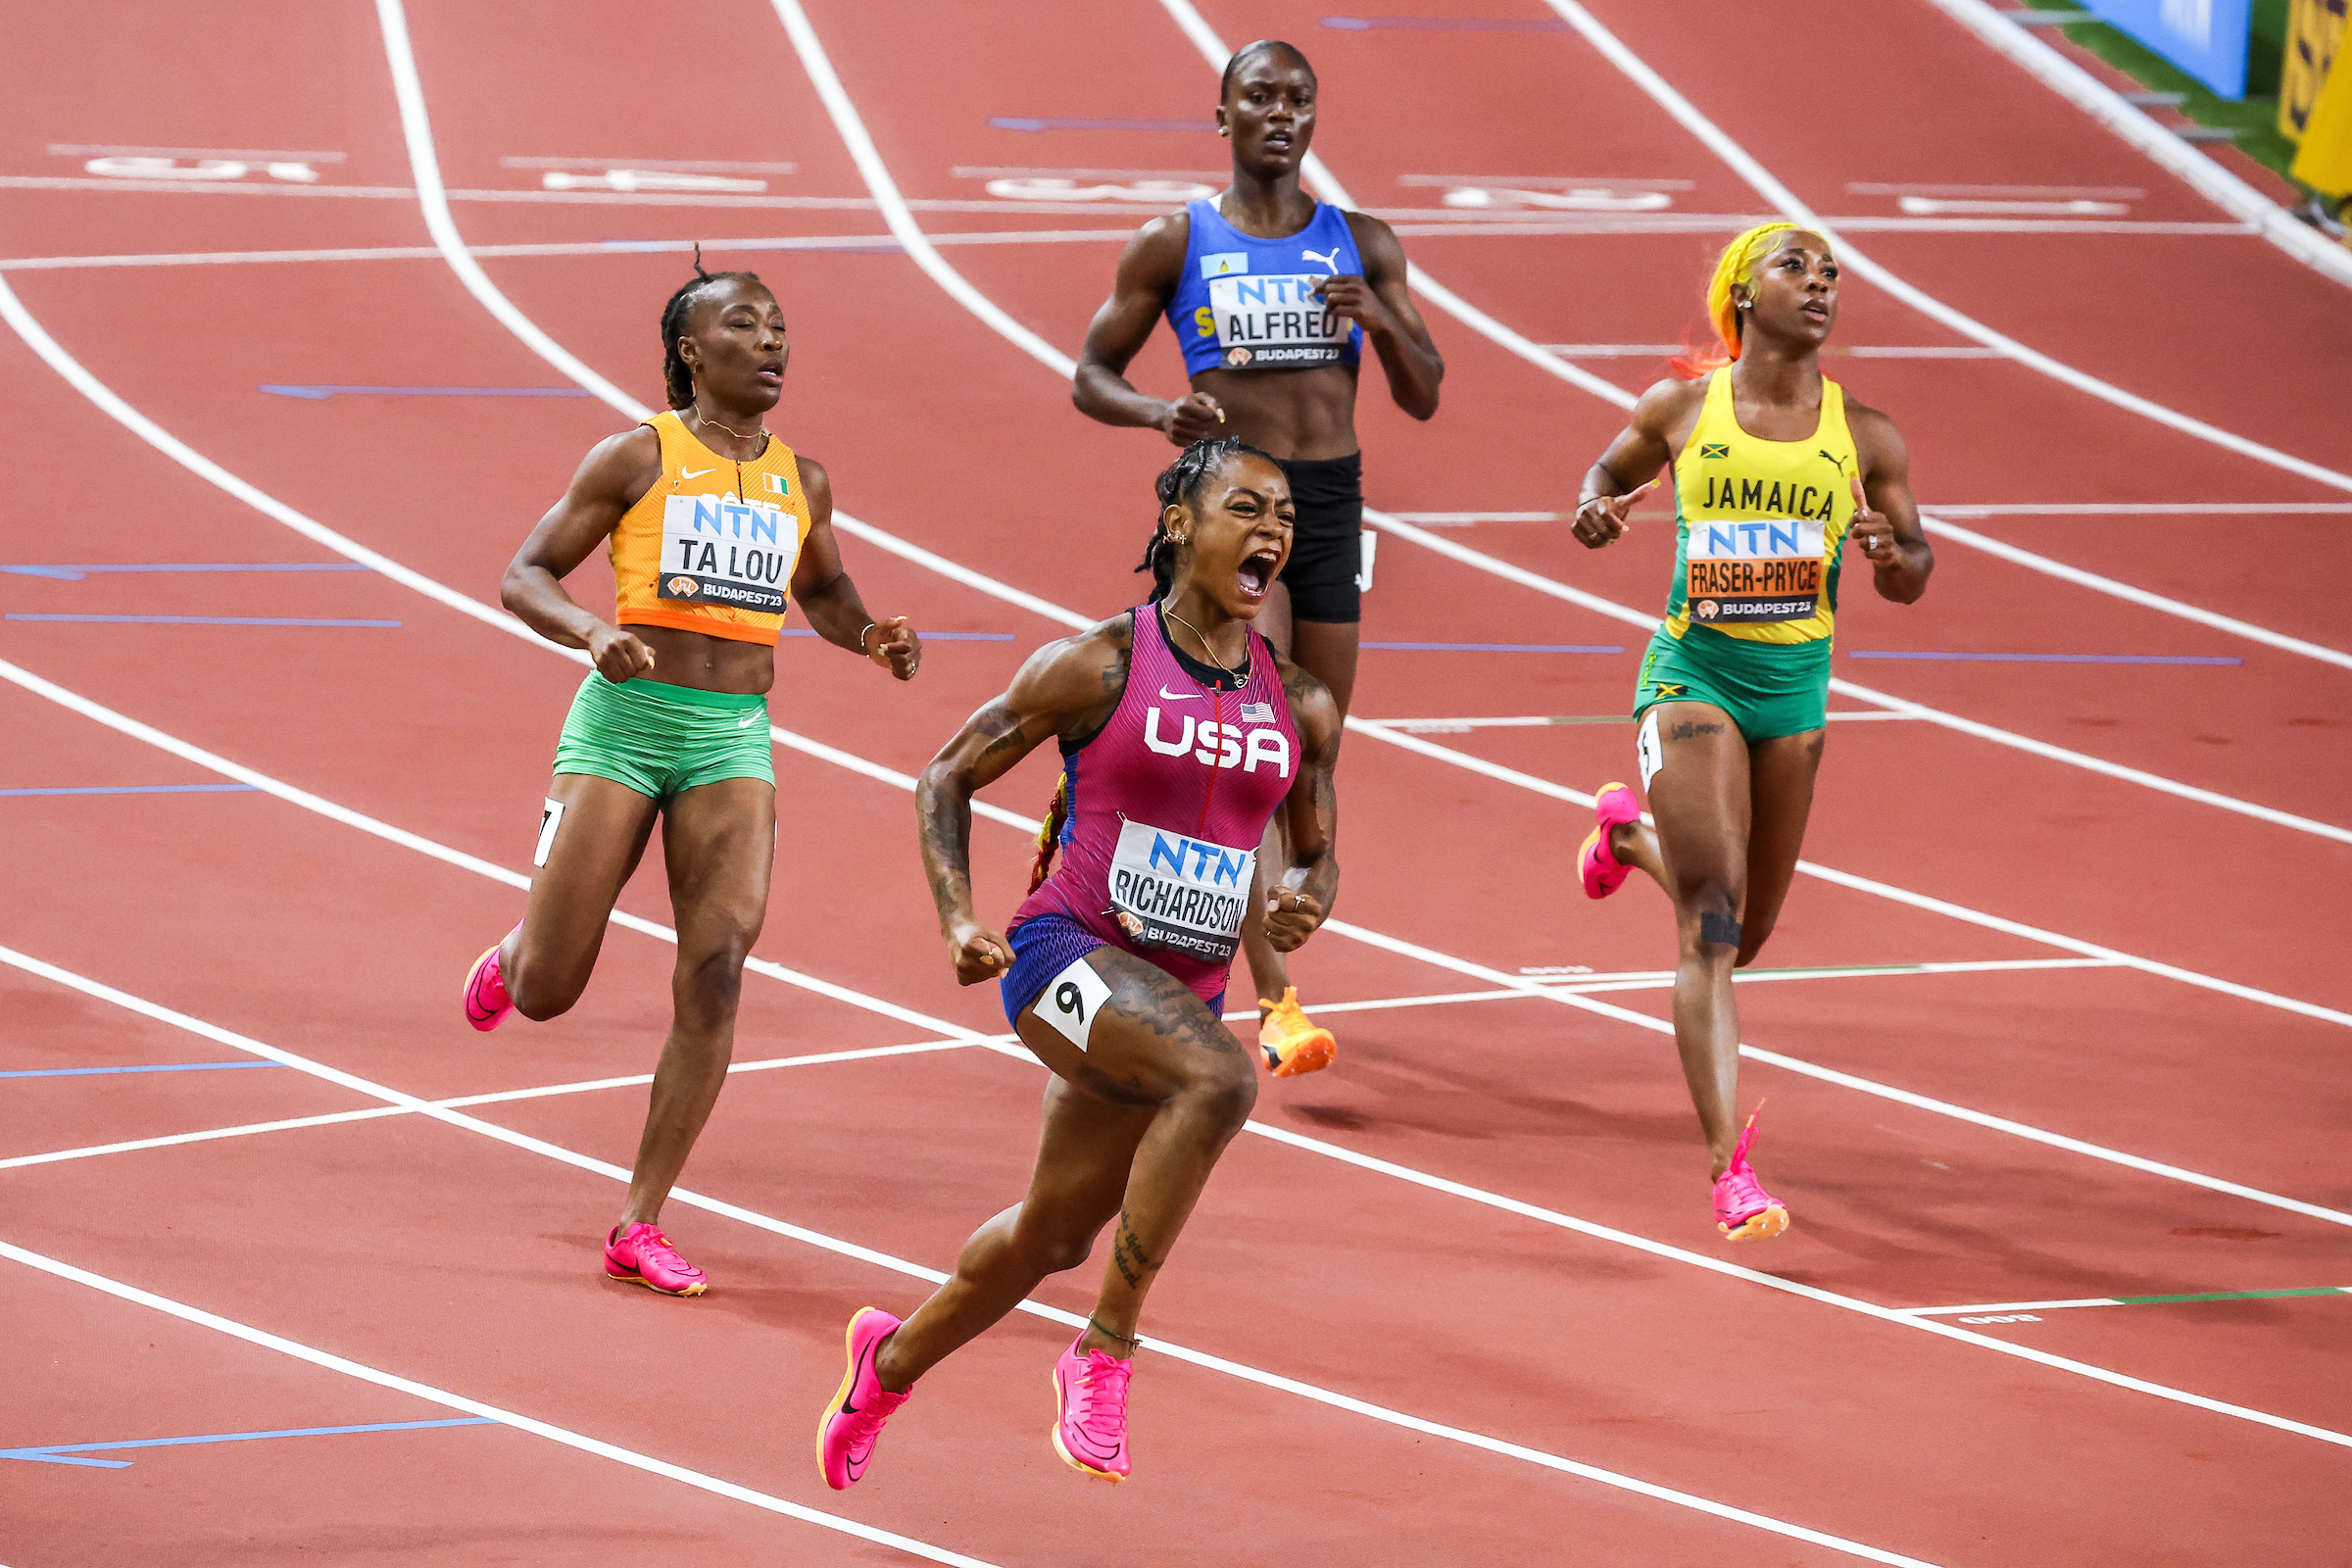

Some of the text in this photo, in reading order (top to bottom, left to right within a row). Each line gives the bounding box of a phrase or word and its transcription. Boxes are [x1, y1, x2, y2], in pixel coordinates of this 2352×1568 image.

[1229, 310, 1340, 342] ALFRED
[1702, 476, 1834, 521] JAMAICA
[693, 499, 777, 546] NTN
[1708, 521, 1799, 556] NTN
[678, 538, 784, 584] TA LOU
[1690, 561, 1819, 593] FRASER-PRYCE
[1143, 706, 1291, 779] USA
[1149, 831, 1247, 890] NTN
[1114, 868, 1245, 933] RICHARDSON
[1055, 981, 1085, 1026] 9
